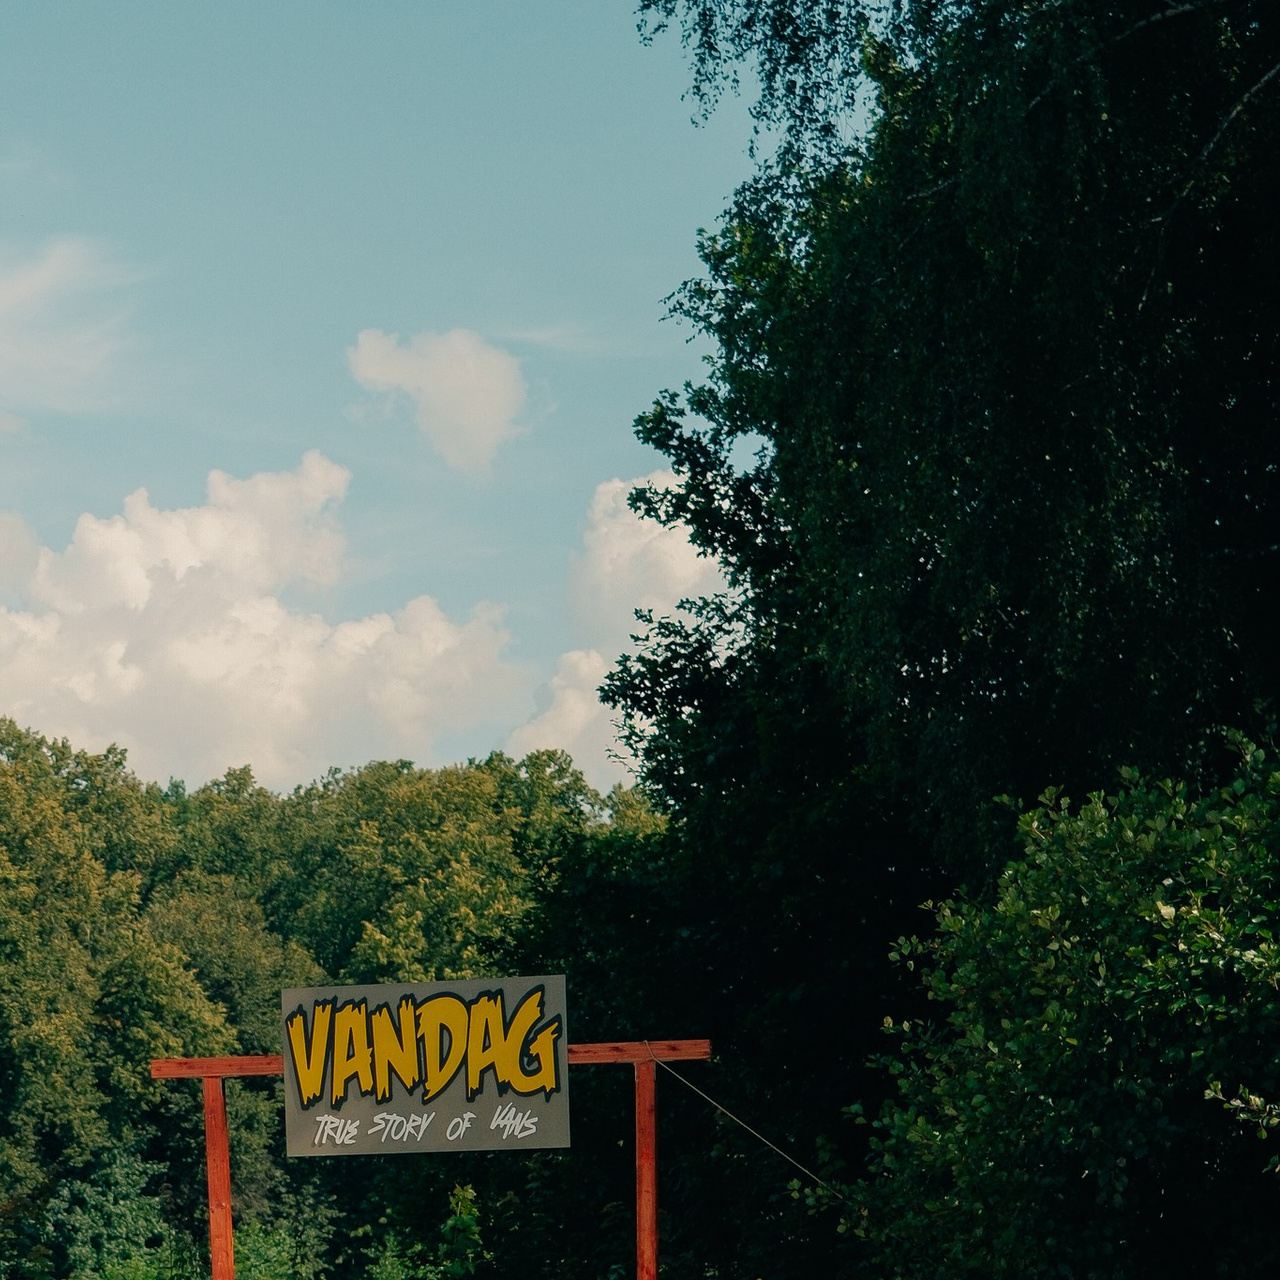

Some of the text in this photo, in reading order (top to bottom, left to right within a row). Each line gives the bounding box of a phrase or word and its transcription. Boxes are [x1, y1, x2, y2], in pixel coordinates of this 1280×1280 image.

[286, 985, 562, 1110] VANDAG
[314, 1102, 539, 1146] TRUE STORY OF VANS
